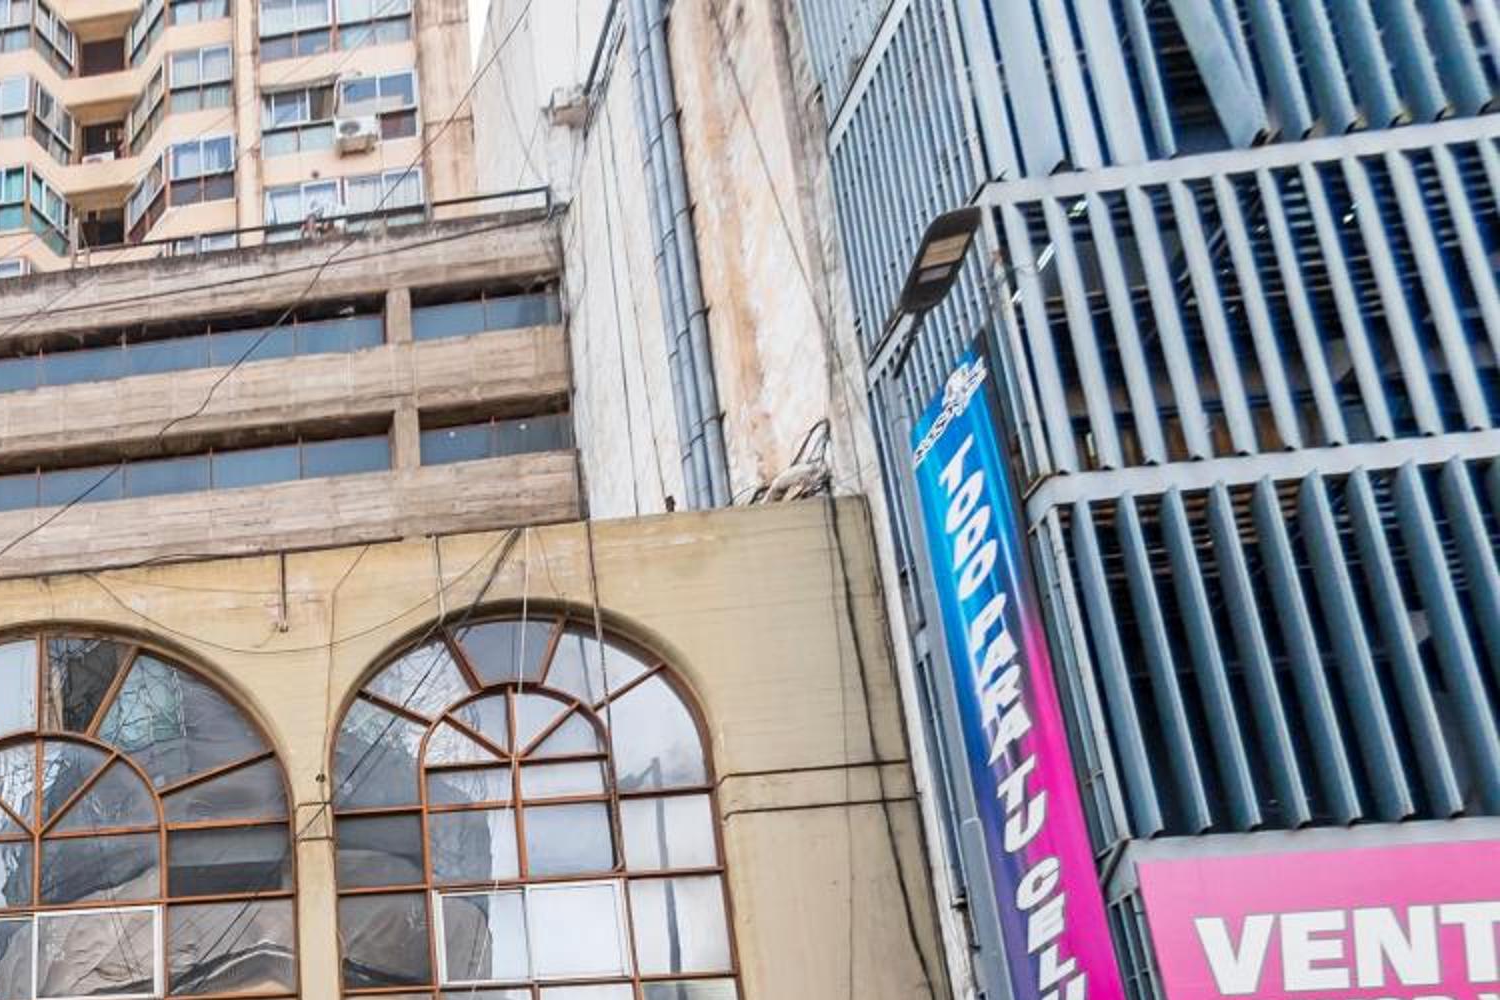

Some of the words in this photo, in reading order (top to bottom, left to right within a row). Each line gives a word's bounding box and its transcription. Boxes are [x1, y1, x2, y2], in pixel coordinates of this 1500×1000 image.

[938, 433, 997, 601] TODO
[970, 593, 1032, 767] PARA
[996, 754, 1046, 853] TU
